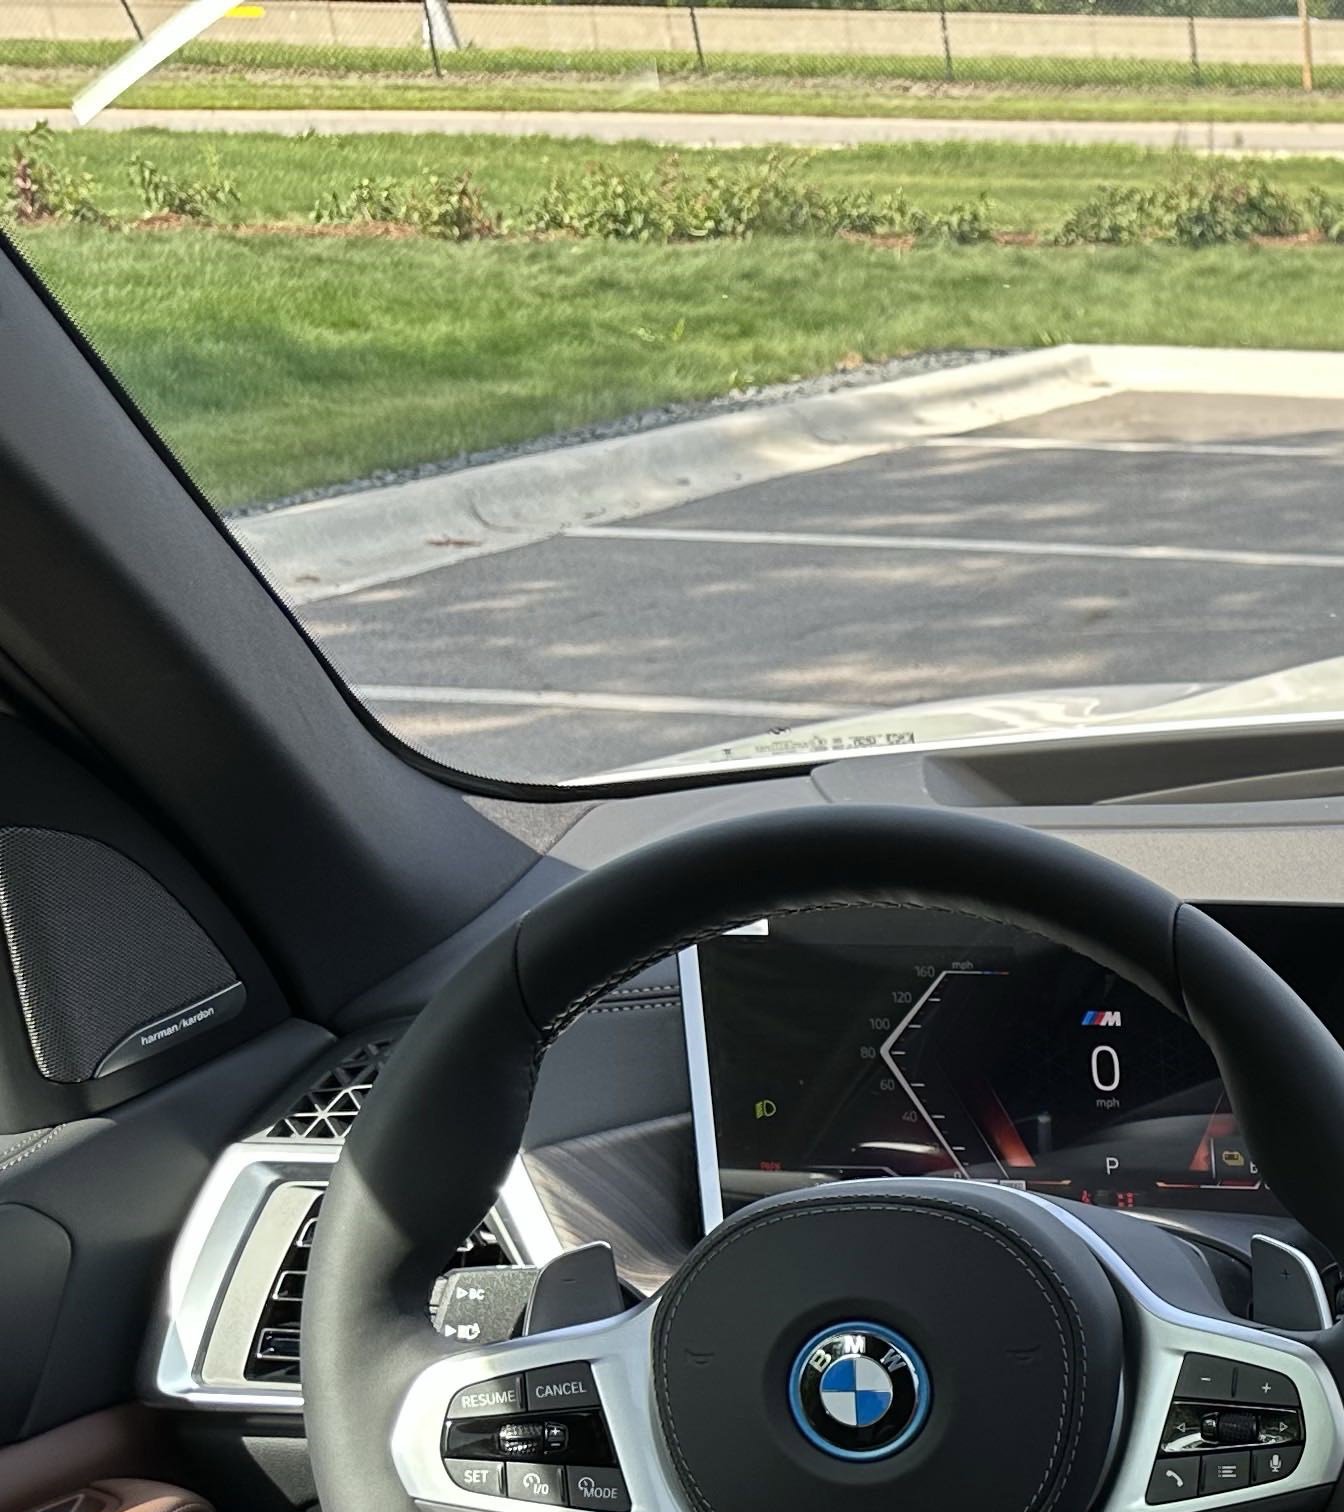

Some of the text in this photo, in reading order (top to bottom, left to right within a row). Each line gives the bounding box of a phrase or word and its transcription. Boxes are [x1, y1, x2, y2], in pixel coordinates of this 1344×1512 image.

[951, 959, 974, 970] mph
[914, 966, 936, 978] 160
[892, 991, 912, 1004] 120
[140, 1005, 215, 1047] harman/kardon
[869, 1017, 891, 1030] 100
[860, 1046, 876, 1059] 80
[1090, 1045, 1121, 1092] 0
[879, 1078, 896, 1091] 60
[1096, 1098, 1120, 1109] mph
[901, 1110, 918, 1122] 40
[1105, 1156, 1120, 1175] P
[809, 1335, 908, 1374] BMW
[535, 1381, 588, 1399] CANCEL
[461, 1389, 517, 1409] RESUME
[463, 1469, 489, 1484] SET
[583, 1487, 619, 1499] MODE
